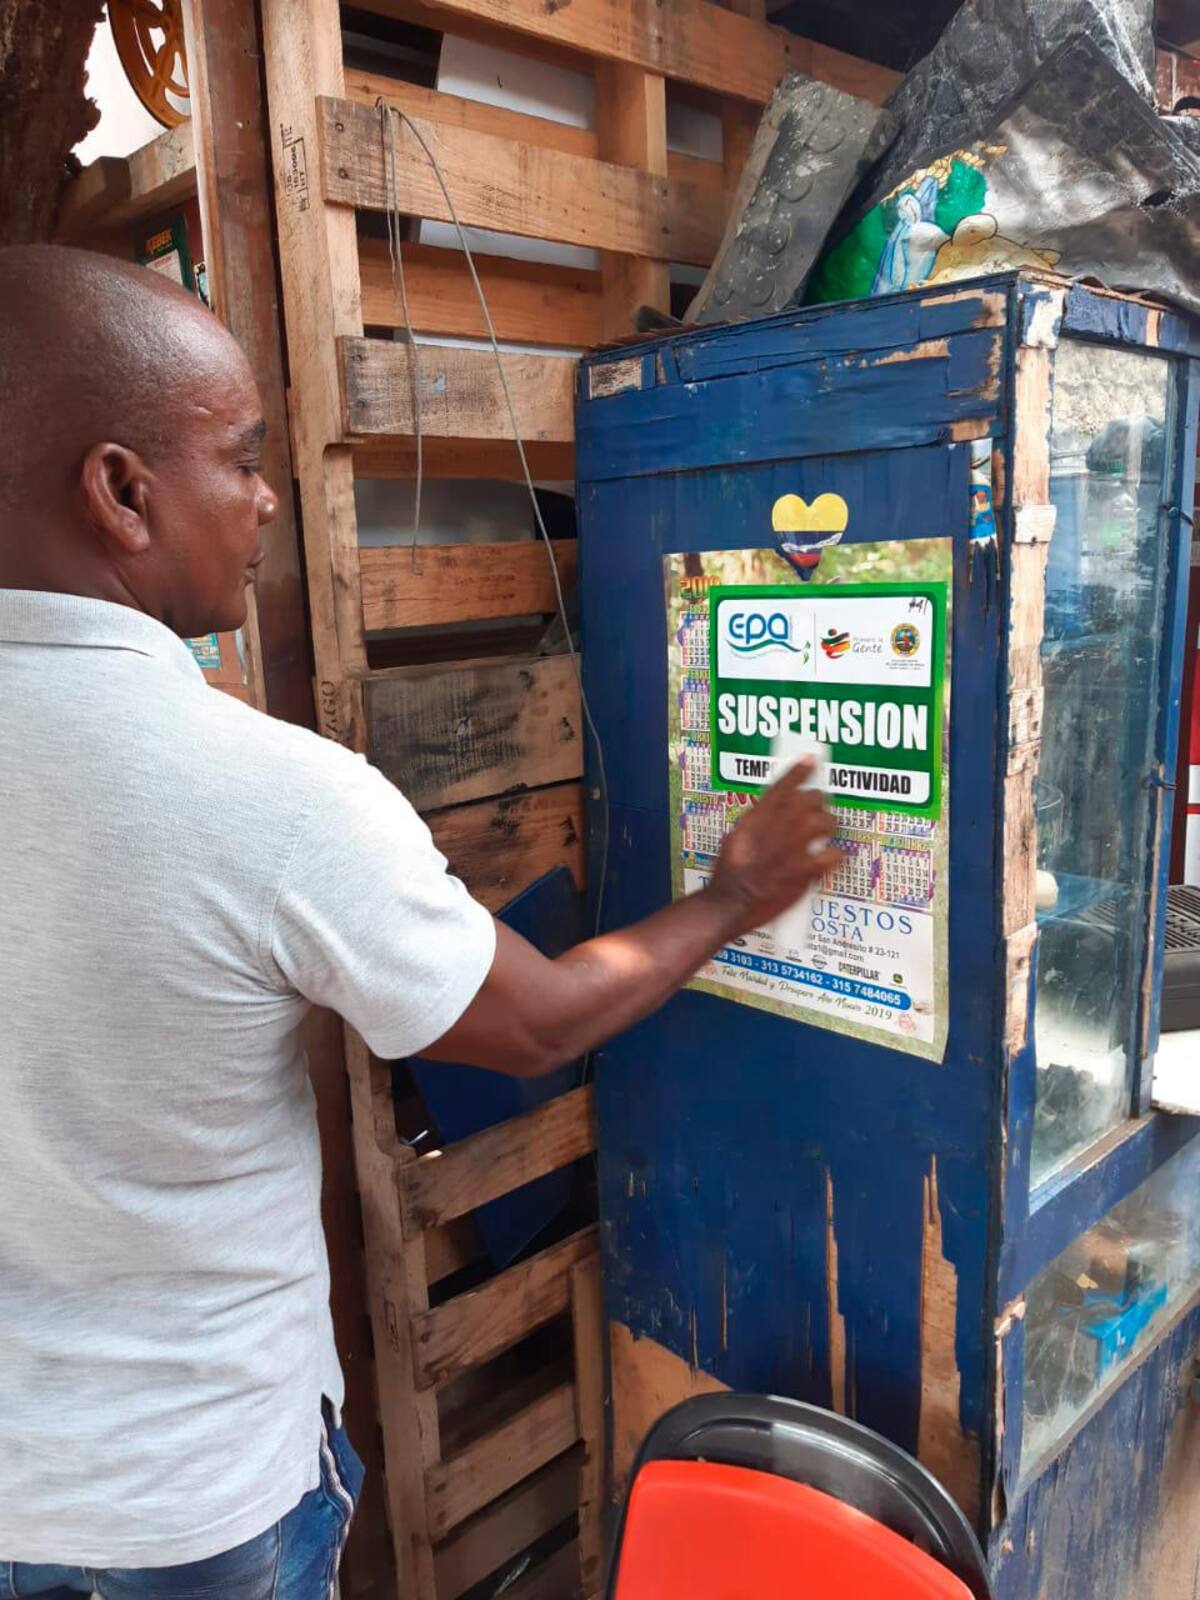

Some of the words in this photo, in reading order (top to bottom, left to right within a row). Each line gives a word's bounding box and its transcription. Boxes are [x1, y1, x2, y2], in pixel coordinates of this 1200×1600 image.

[718, 692, 928, 751] SUSPENSION
[735, 758, 771, 778] TEMP
[829, 768, 911, 795] ACTIVIDAD
[811, 899, 913, 935] UESTOS
[811, 917, 863, 942] OSTA
[760, 960, 779, 974] 313
[831, 978, 852, 993] 315
[838, 961, 881, 982] CATERPILLAR
[864, 1004, 893, 1020] 2019
